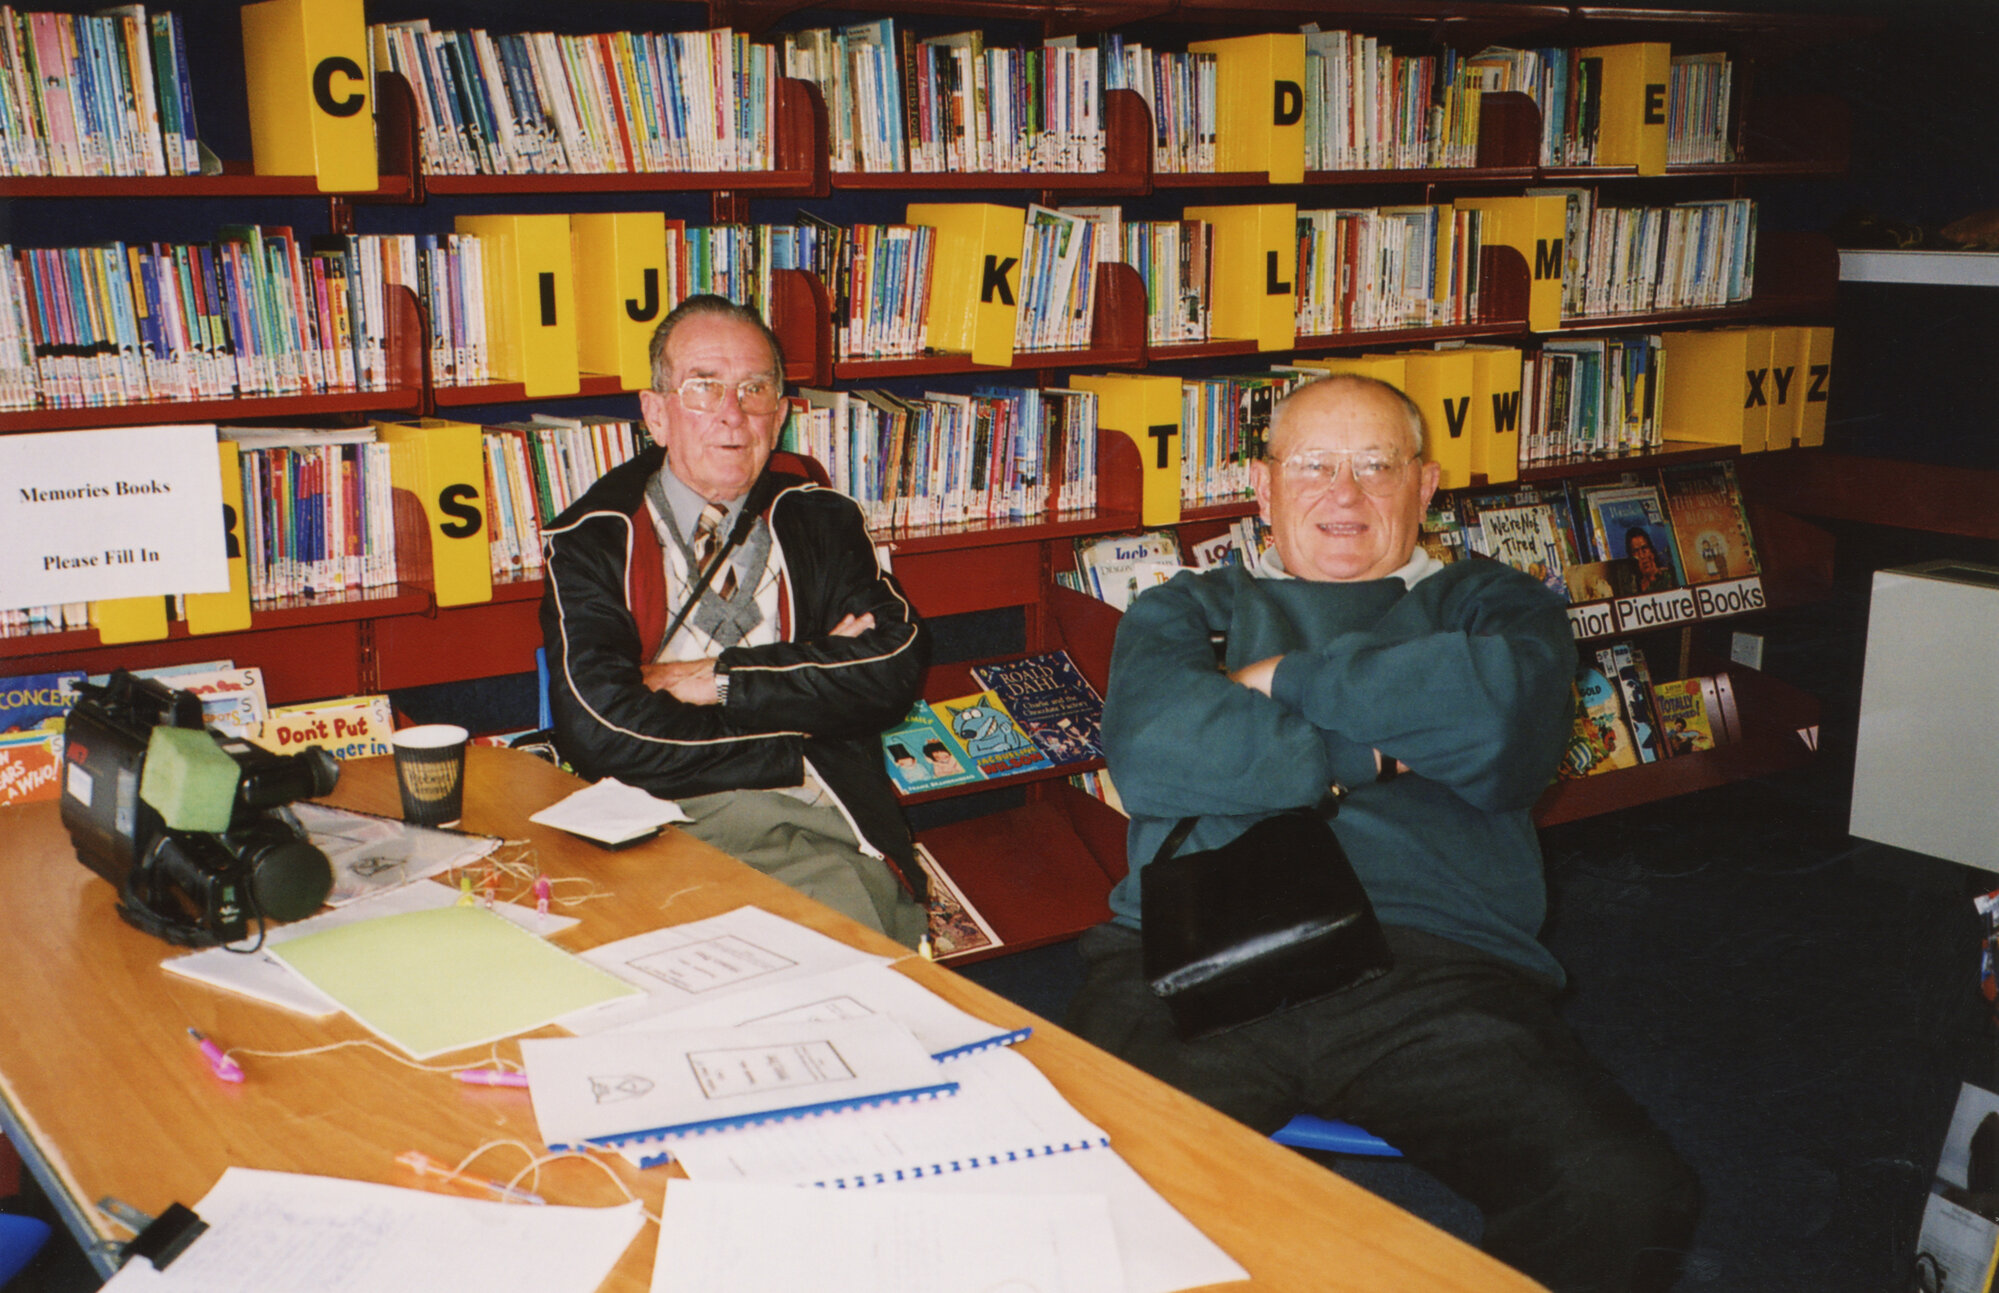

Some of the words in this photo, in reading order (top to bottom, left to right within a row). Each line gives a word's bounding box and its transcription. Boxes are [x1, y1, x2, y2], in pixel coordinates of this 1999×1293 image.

[313, 57, 365, 117] C
[1274, 80, 1303, 125] D
[1644, 84, 1667, 125] E
[1266, 251, 1291, 295] L
[1535, 239, 1563, 280] M
[540, 273, 556, 326] I
[626, 269, 659, 322] J
[981, 255, 1018, 306] K
[1745, 368, 1769, 409] X
[1773, 366, 1796, 406] Y
[1808, 364, 1830, 403] Z
[1444, 397, 1470, 438] V
[1493, 391, 1520, 433] W
[1148, 423, 1178, 469] T
[20, 483, 110, 503] Memories
[115, 479, 171, 497] Books
[439, 483, 482, 539] S
[1490, 514, 1521, 536] We're
[1521, 512, 1540, 535] Not
[43, 554, 98, 571] Please
[105, 549, 134, 565] Fill
[140, 548, 160, 562] In
[1502, 536, 1538, 557] Tired
[1569, 609, 1610, 638] nior
[1617, 596, 1694, 628] Picture
[1698, 583, 1765, 616] Books
[243, 670, 255, 686] S
[1000, 666, 1054, 684] ROALD
[1008, 677, 1065, 696] DAHL
[241, 697, 252, 713] S
[276, 720, 329, 746] Don't
[333, 716, 368, 739] Put
[370, 737, 388, 756] in
[16, 754, 60, 797] WHO!
[976, 746, 1036, 766] JACQUELINE
[980, 753, 1045, 775] WILSON
